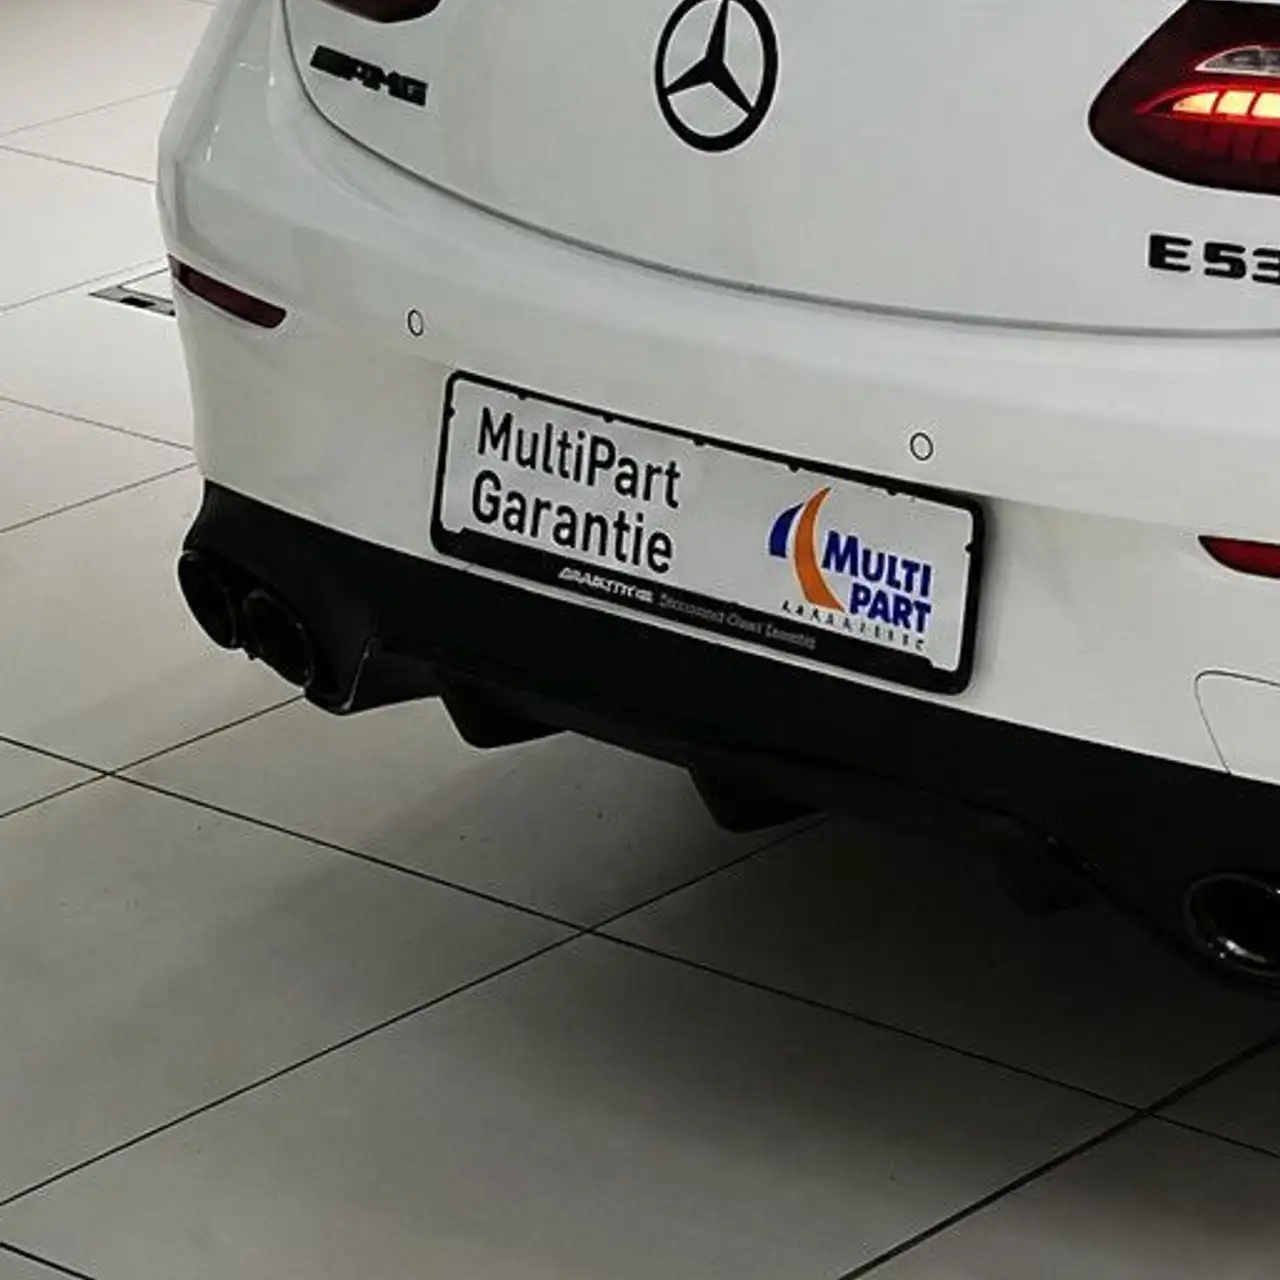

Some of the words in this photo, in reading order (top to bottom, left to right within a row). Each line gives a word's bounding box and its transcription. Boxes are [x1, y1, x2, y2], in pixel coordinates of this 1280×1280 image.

[477, 406, 681, 509] MultiPart
[472, 469, 673, 574] Garantie
[820, 530, 932, 597] MULTI
[850, 582, 932, 634] PART
